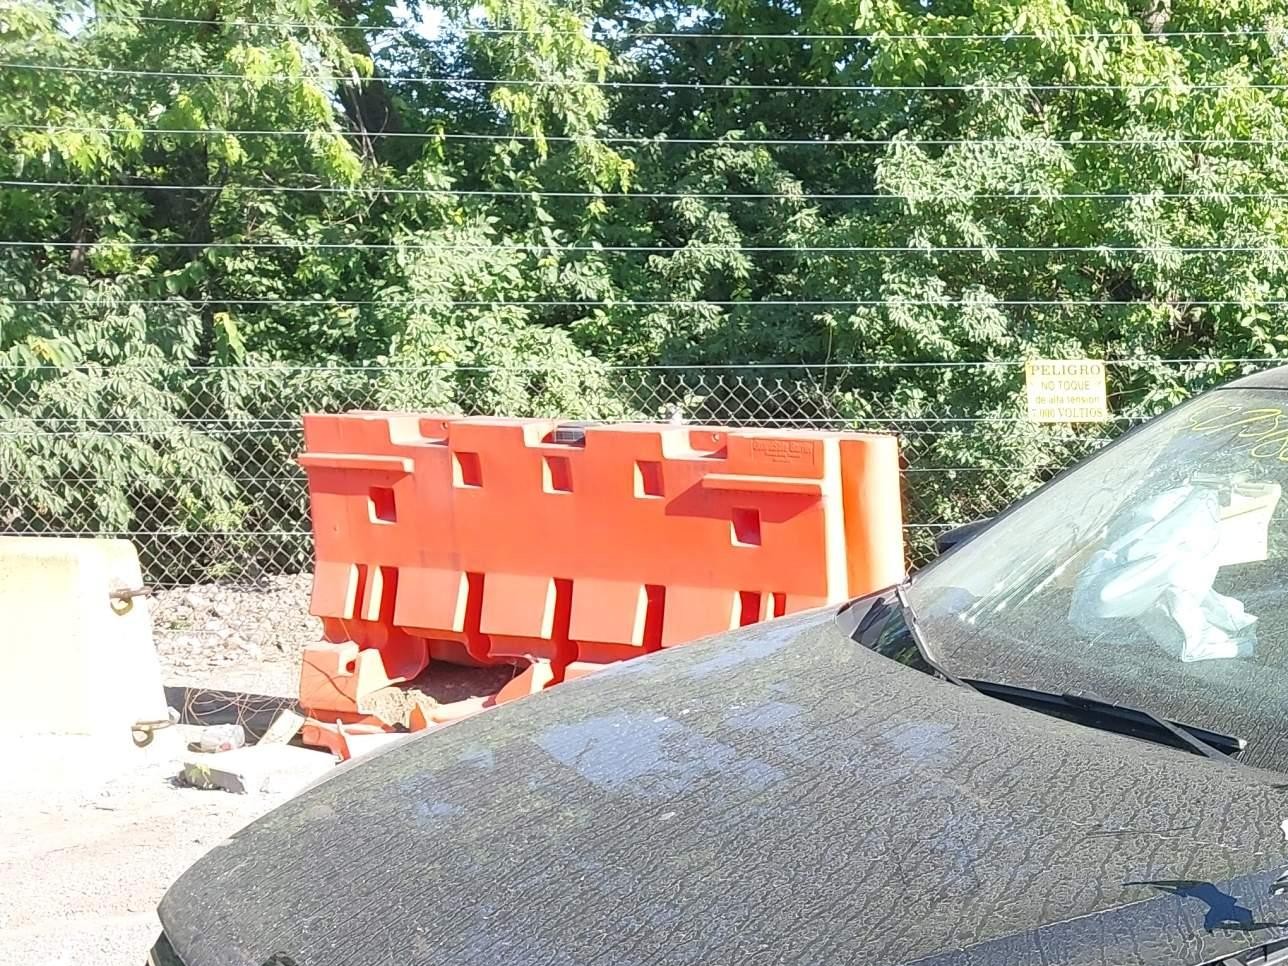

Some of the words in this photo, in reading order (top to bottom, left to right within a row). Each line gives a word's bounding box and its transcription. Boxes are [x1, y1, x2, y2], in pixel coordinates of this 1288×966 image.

[1029, 364, 1101, 376] PELIGRO
[1041, 380, 1056, 391] NO
[1058, 380, 1090, 391] TOQUE
[1057, 407, 1103, 418] VOLTIOS
